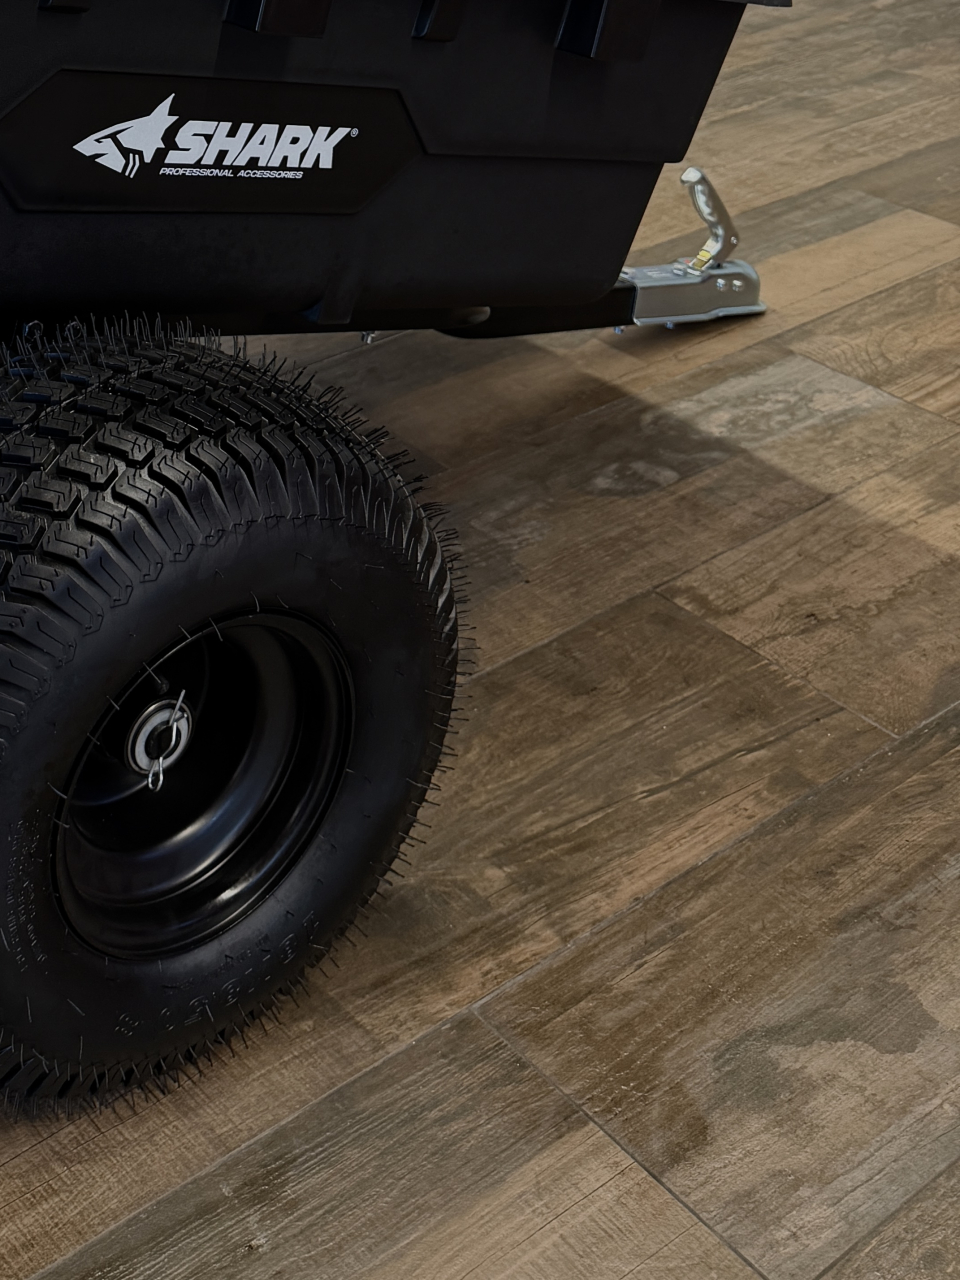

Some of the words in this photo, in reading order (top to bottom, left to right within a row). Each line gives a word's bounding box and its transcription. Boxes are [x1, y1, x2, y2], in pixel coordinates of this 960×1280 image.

[164, 120, 352, 169] SHARK
[159, 167, 234, 178] PROFESSIONAL
[236, 169, 304, 179] ACCESSORIES
